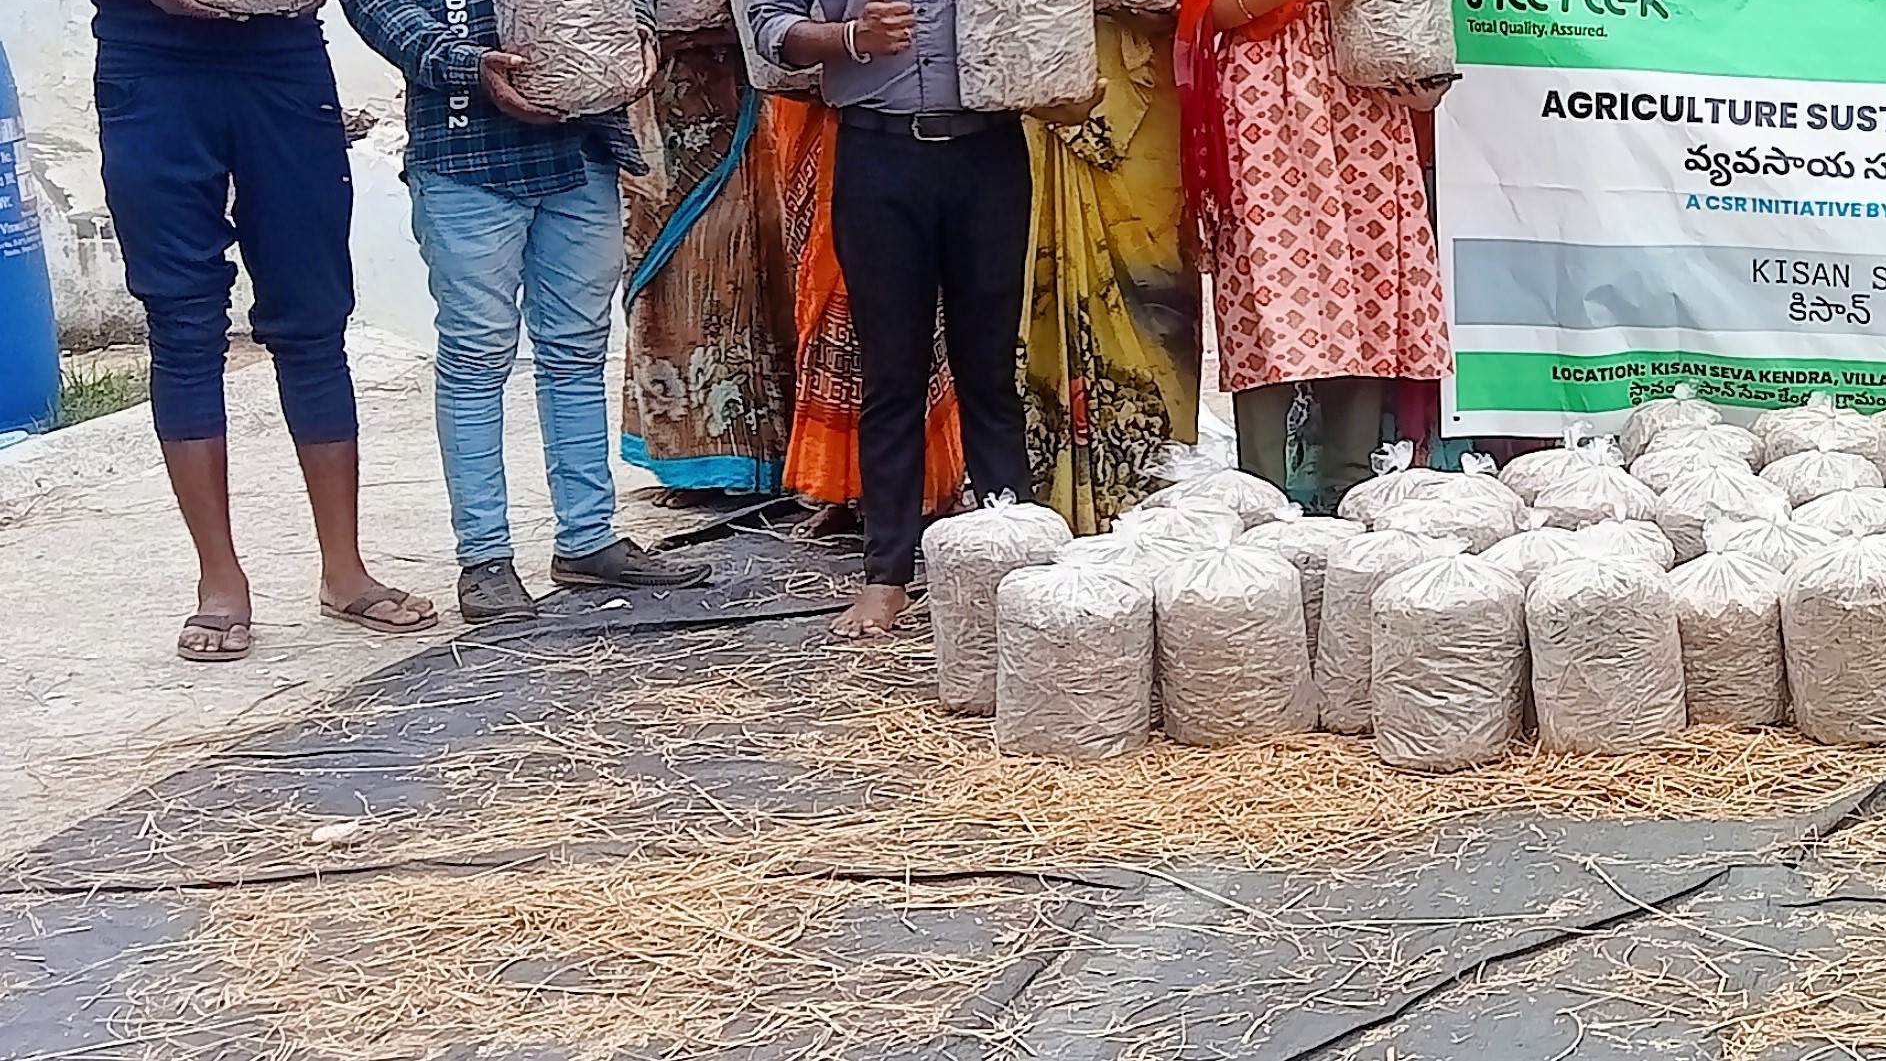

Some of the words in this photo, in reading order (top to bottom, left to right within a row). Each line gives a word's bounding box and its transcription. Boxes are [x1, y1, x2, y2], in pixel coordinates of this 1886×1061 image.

[1467, 19, 1497, 34] Total
[1550, 23, 1608, 37] Assured.
[1541, 90, 1798, 129] AGRICULTURE
[1684, 143, 1855, 187] వ్యవసాయ
[1686, 194, 1700, 210] A
[1706, 195, 1746, 213] CSR
[1752, 198, 1861, 218] INITIATIVE
[1752, 258, 1850, 288] KISAN
[1788, 292, 1871, 325] కిసాన్
[1552, 363, 1646, 382] LOCATION:
[1651, 362, 1707, 377] KISAN
[1710, 366, 1753, 382] SEVA
[1759, 370, 1839, 386] KENDRA,
